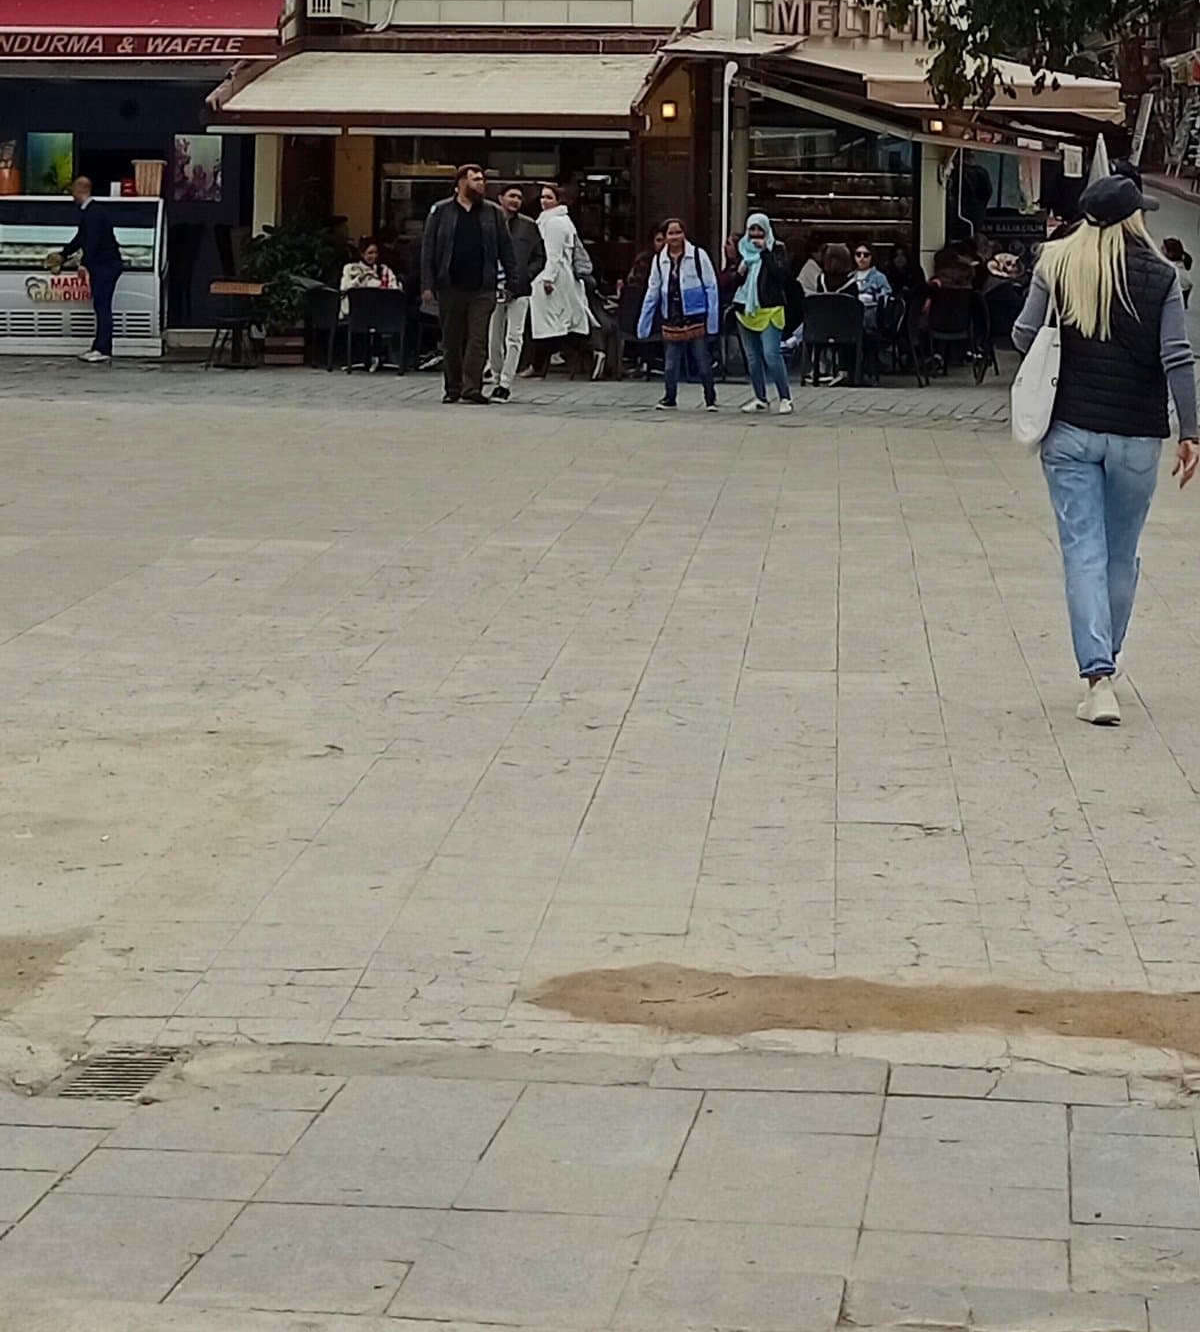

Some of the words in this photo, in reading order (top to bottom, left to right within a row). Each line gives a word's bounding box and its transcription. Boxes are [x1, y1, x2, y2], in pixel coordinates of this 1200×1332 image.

[0, 34, 104, 53] NDURMA
[116, 36, 136, 54] &
[146, 36, 243, 54] WAFFLE
